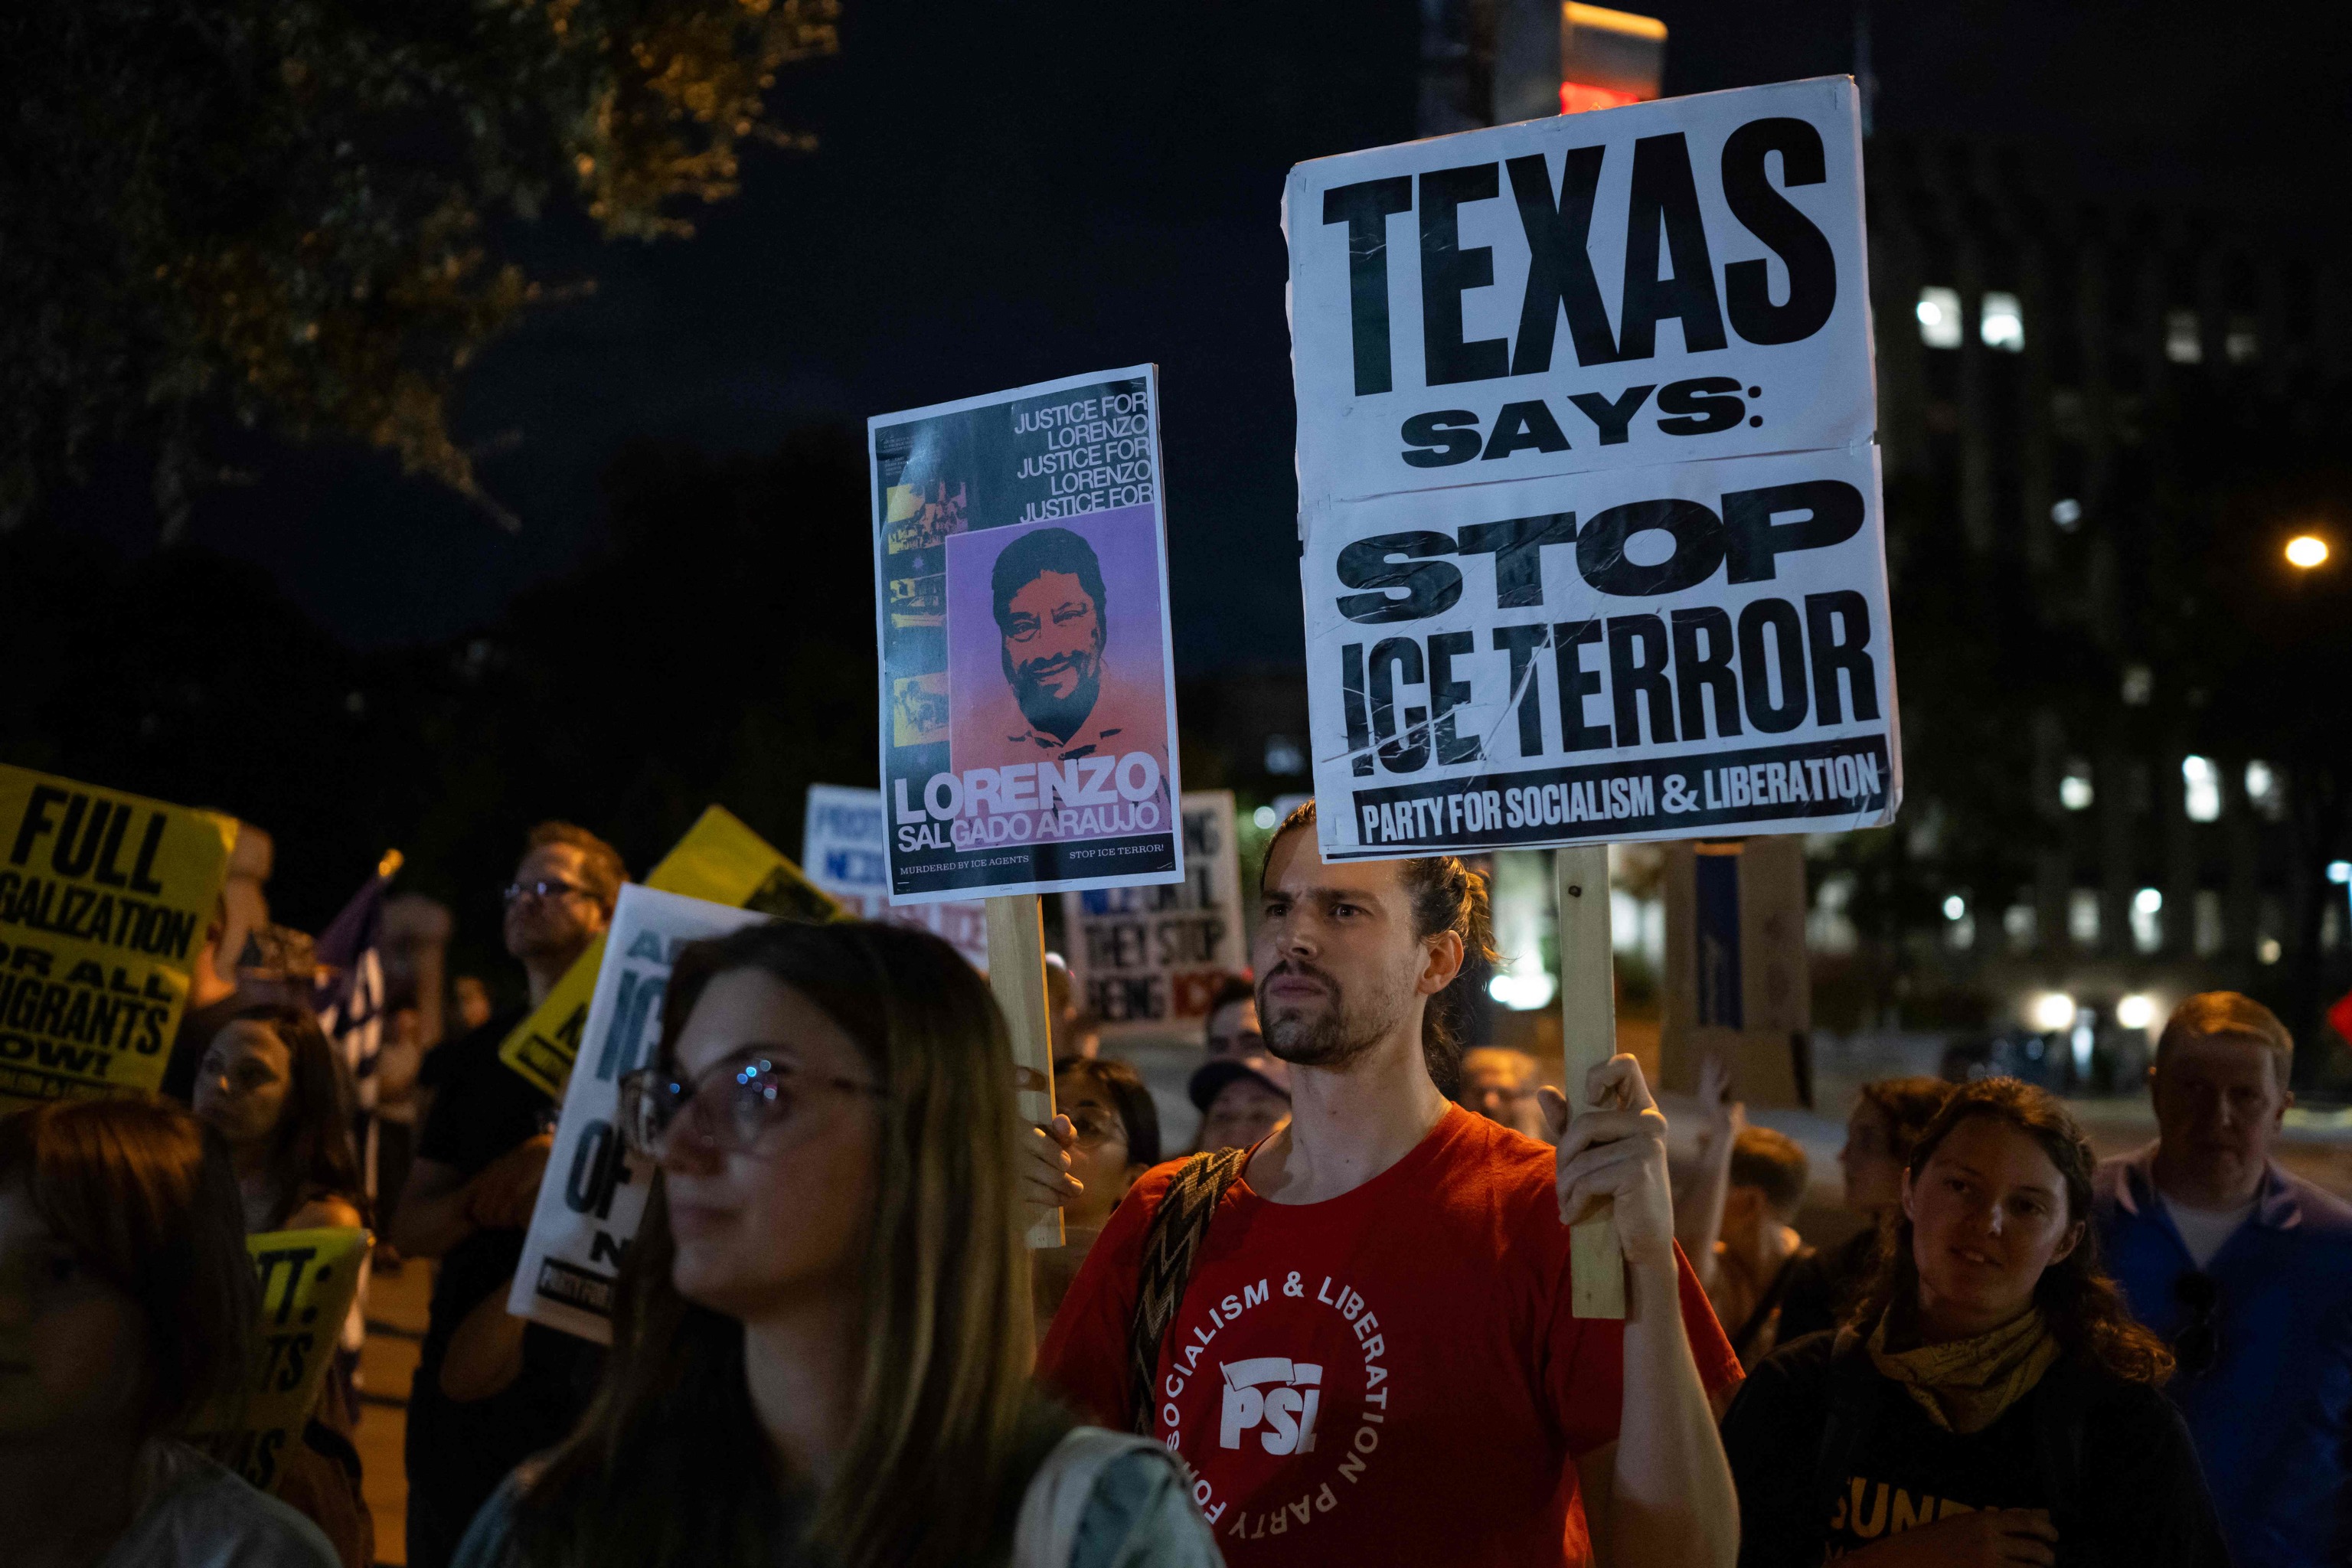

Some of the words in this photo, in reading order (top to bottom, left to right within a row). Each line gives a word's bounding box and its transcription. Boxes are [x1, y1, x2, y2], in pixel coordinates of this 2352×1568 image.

[1323, 116, 1837, 397] TEXAS
[1014, 398, 1097, 434] JUSTICE
[1102, 391, 1148, 415] FOR
[1047, 413, 1148, 451] LORENZO
[1400, 375, 1763, 469] SAYS:
[1018, 444, 1101, 479] JUSTICE
[1105, 436, 1150, 461] FOR
[1051, 459, 1152, 495] LORENZO
[1021, 490, 1104, 524] JUSTICE
[1109, 482, 1153, 509] FOR
[1334, 479, 1865, 625] STOP
[1341, 630, 1483, 777] ICE
[1493, 589, 1881, 757] TERROR
[894, 751, 1161, 825] LORENZO
[1362, 796, 1443, 844] PARTY
[1447, 789, 1503, 835] FOR
[1504, 774, 1655, 829] SOCIALISM
[1661, 773, 1701, 814] &
[1703, 751, 1882, 811] LIBERATION
[11, 785, 166, 896] FULL
[897, 813, 1032, 853] SALGADO
[1037, 802, 1159, 839] ARAUJO
[1070, 850, 1096, 860] STOP
[1098, 848, 1116, 858] ICE
[1118, 844, 1165, 855] TERROR!
[900, 862, 956, 876] MURDERED
[958, 861, 969, 870] BY
[972, 858, 987, 867] ICE
[989, 854, 1029, 866] AGENTS
[66, 959, 172, 1002] ALL
[0, 972, 168, 1056] IGRANTS
[1282, 1271, 1305, 1298] &
[1162, 1278, 1269, 1452] SOCIALISM
[1317, 1276, 1388, 1485] LIBERATION
[1228, 1482, 1339, 1540] PARTY
